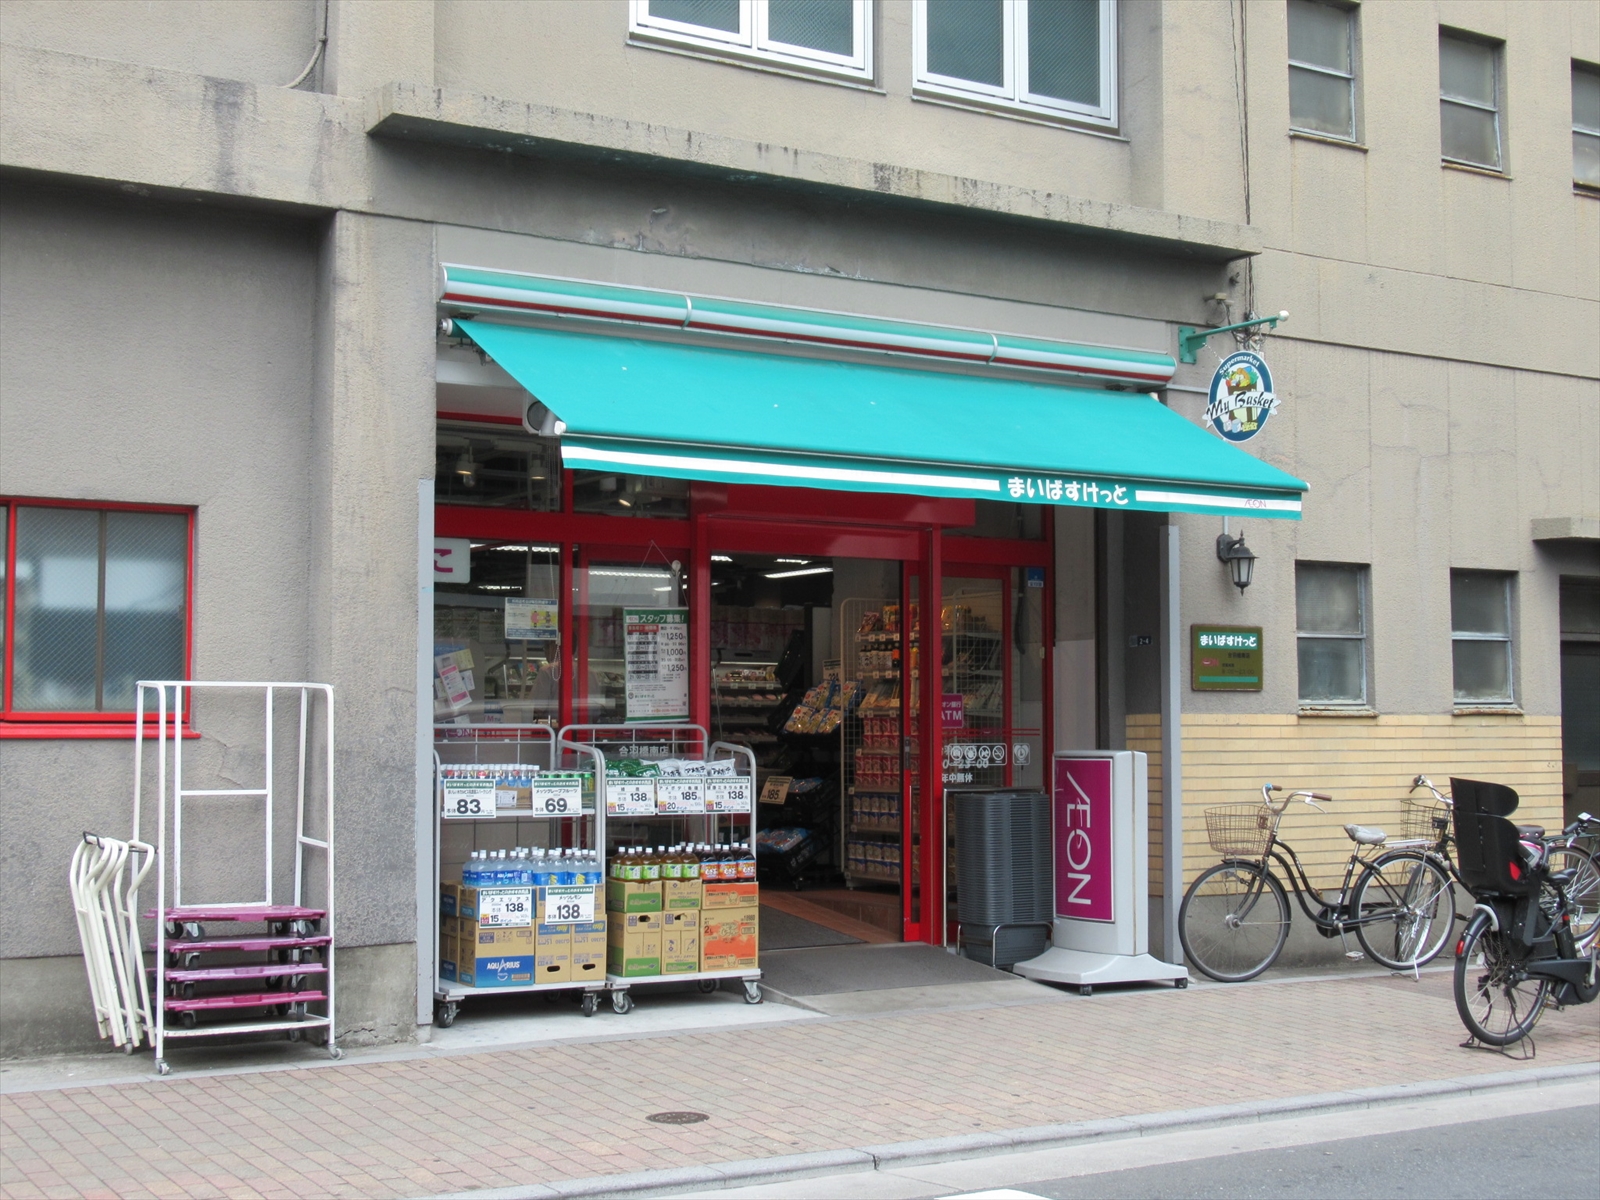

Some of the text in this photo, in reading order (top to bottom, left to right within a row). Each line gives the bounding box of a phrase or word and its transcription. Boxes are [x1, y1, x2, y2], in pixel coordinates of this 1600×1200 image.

[1219, 355, 1260, 375] Supermarket
[1206, 391, 1275, 420] My Basket
[1008, 476, 1129, 506] まいばすけっと
[1200, 634, 1257, 647] まいばすけっと
[630, 792, 647, 802] 138
[681, 792, 698, 800] 185
[728, 791, 744, 799] 138
[456, 799, 482, 814] 83
[545, 798, 568, 813] 69
[617, 803, 625, 811] 15
[667, 802, 676, 810] 20
[715, 801, 723, 809] 15
[505, 902, 524, 912] 138
[557, 904, 580, 920] 138
[490, 915, 499, 923] 15
[486, 958, 521, 973] AQUARIUS
